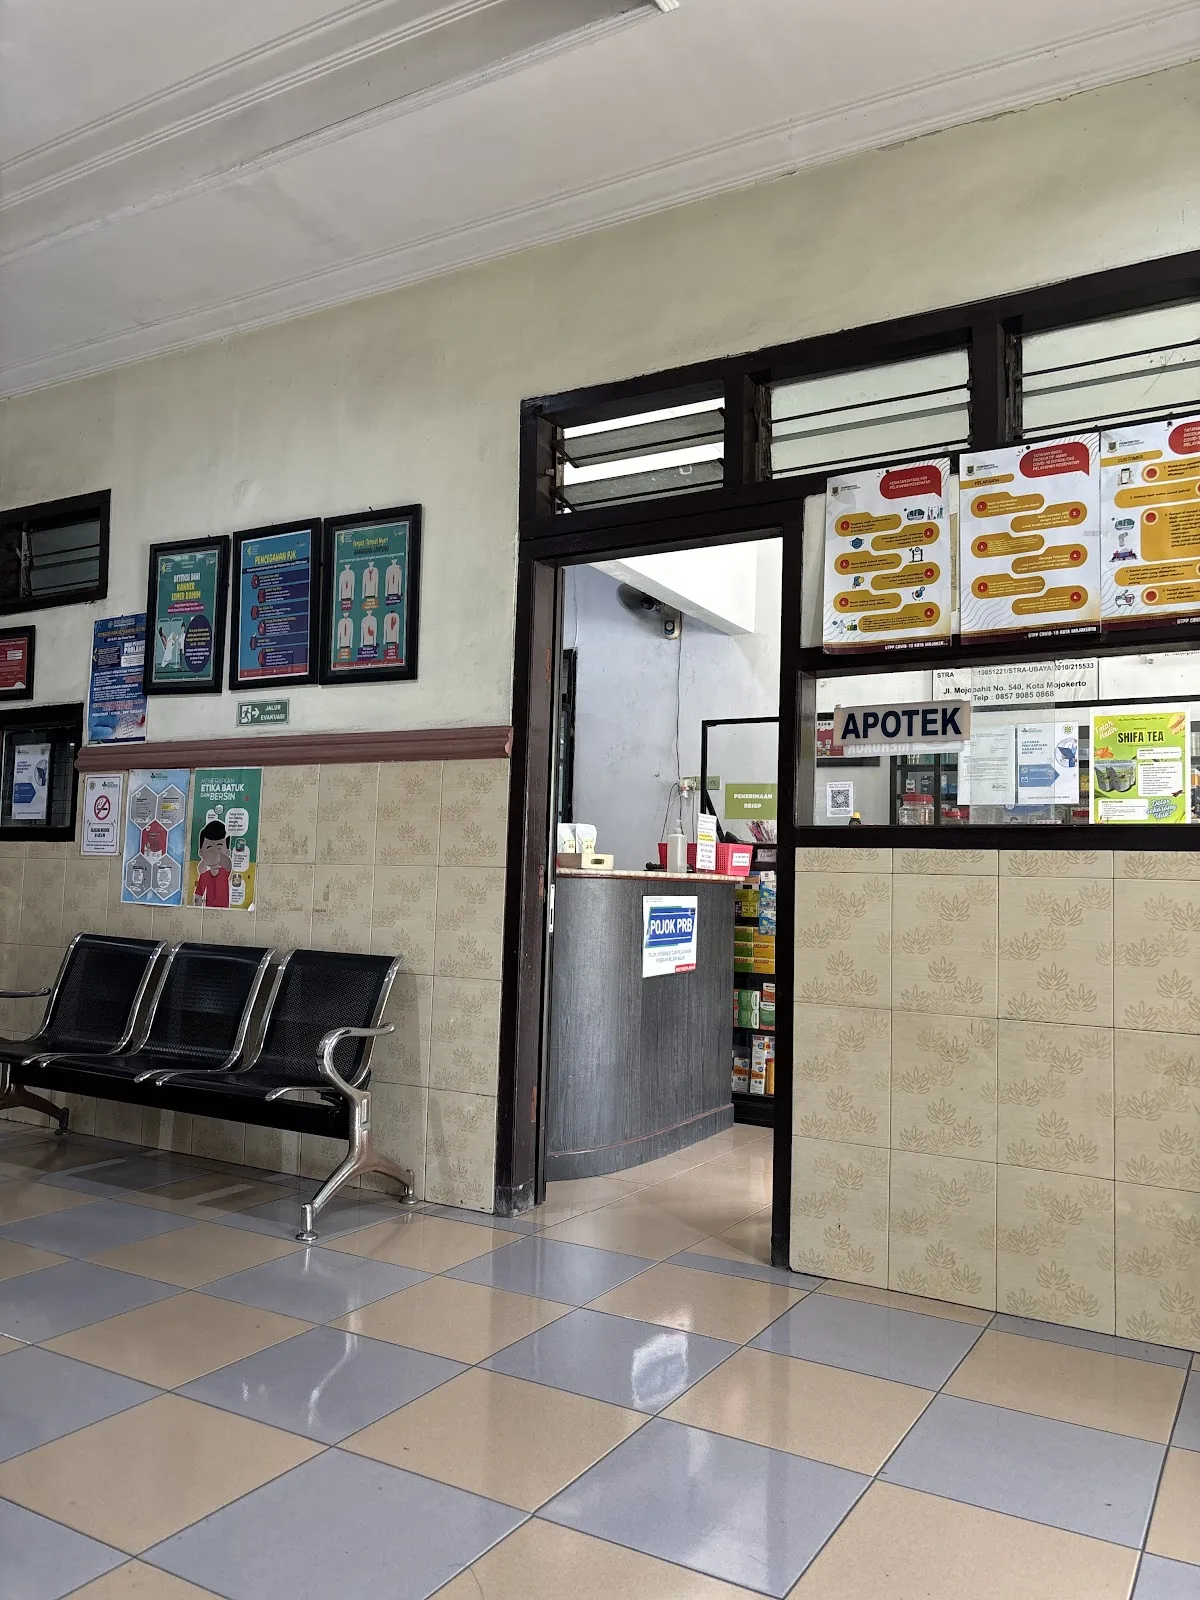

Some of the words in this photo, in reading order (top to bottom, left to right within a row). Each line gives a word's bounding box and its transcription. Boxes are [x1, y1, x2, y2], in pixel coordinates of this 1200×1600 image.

[1118, 455, 1144, 463] CUSTOMER
[254, 552, 287, 566] PENCEGAHAN
[936, 671, 955, 679] STRA
[992, 684, 1006, 692] No.
[1008, 683, 1024, 692] 540,
[1026, 681, 1045, 690] Kota
[1046, 680, 1087, 690] Mojokerto
[973, 694, 989, 702] Telp
[995, 692, 1014, 700] 0857
[1015, 691, 1035, 699] 9085
[260, 713, 286, 721] EVAKUASI
[840, 707, 962, 740] APOTEK
[1094, 720, 1115, 735] Telah
[1117, 731, 1144, 744] SHIFA
[1147, 730, 1164, 742] TEA
[200, 784, 221, 792] ETIKA
[221, 783, 245, 792] BATUK
[210, 792, 236, 801] BERSIN
[1150, 798, 1170, 808] Detox
[650, 918, 676, 936] POJOK
[676, 918, 693, 934] PRB
